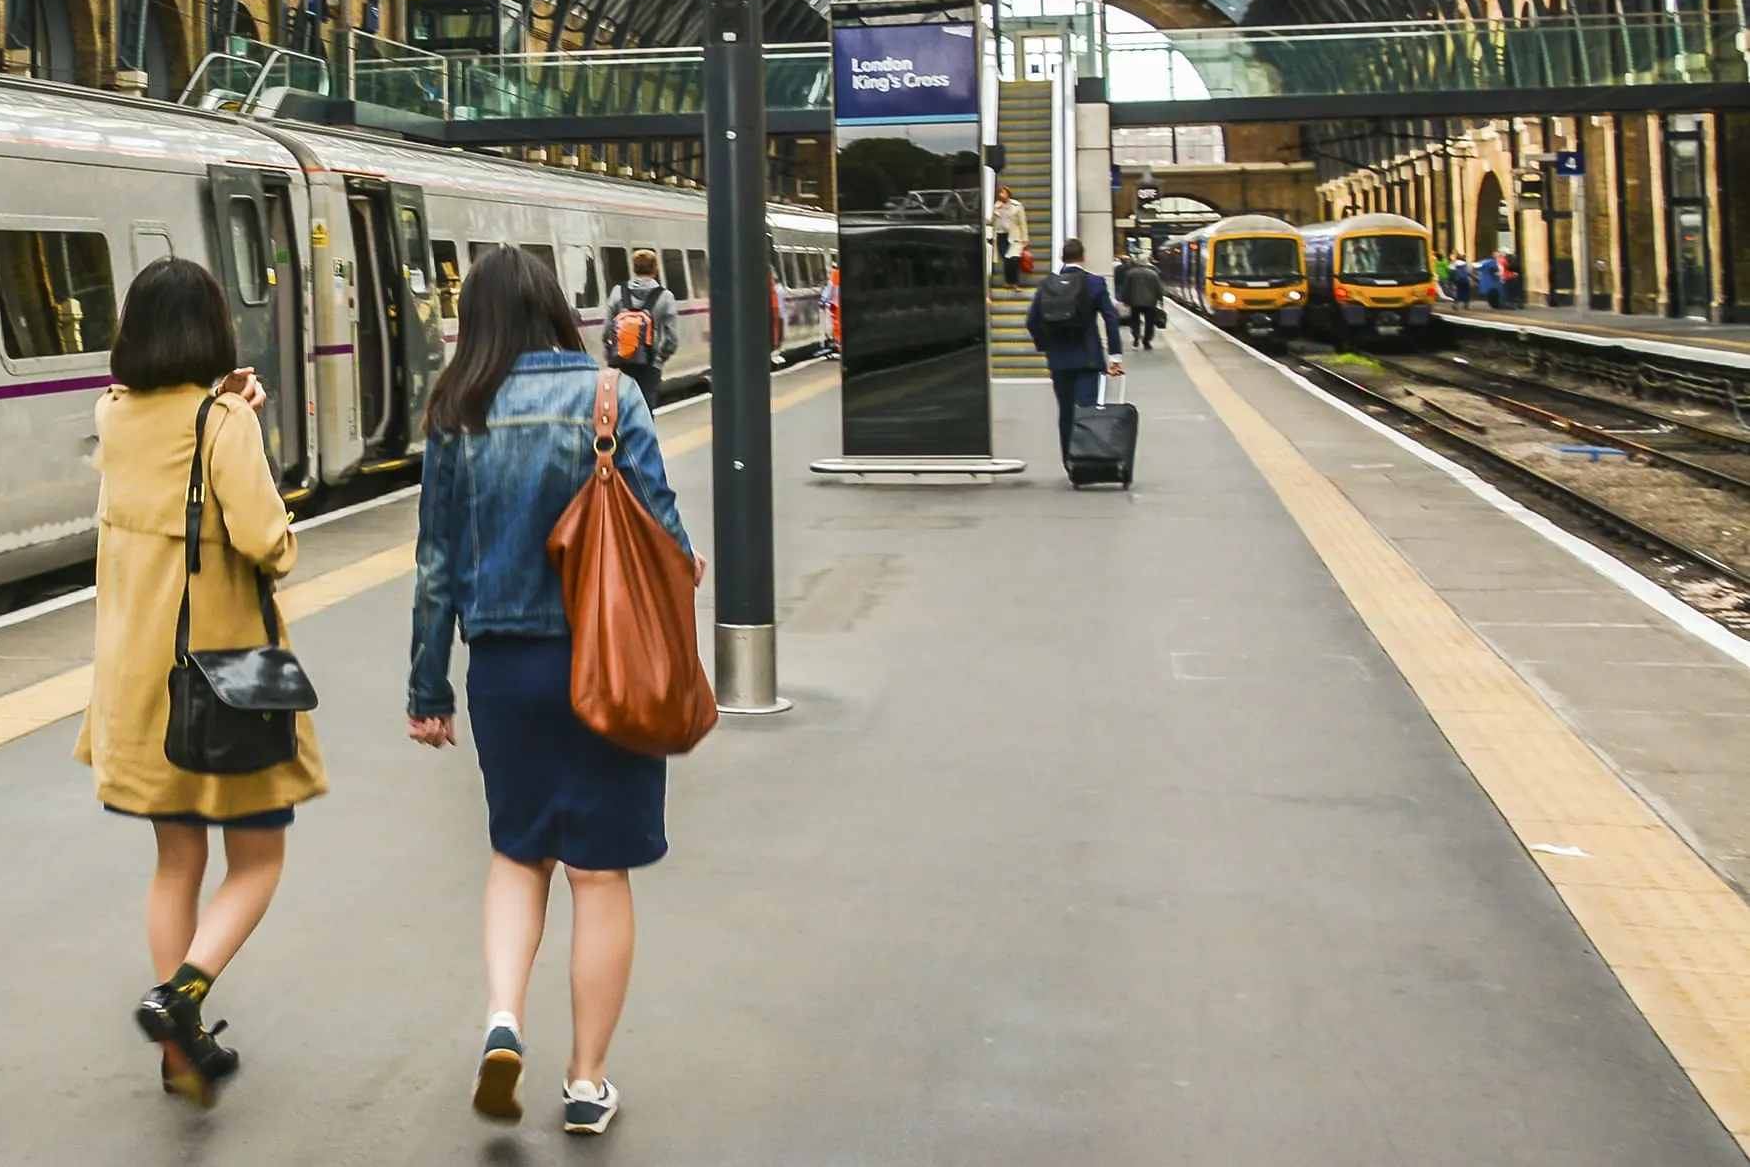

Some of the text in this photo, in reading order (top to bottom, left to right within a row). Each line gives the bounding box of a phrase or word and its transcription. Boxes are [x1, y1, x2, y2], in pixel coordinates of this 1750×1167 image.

[851, 56, 913, 73] London
[852, 72, 950, 92] King's Cross
[1565, 157, 1577, 170] 4
